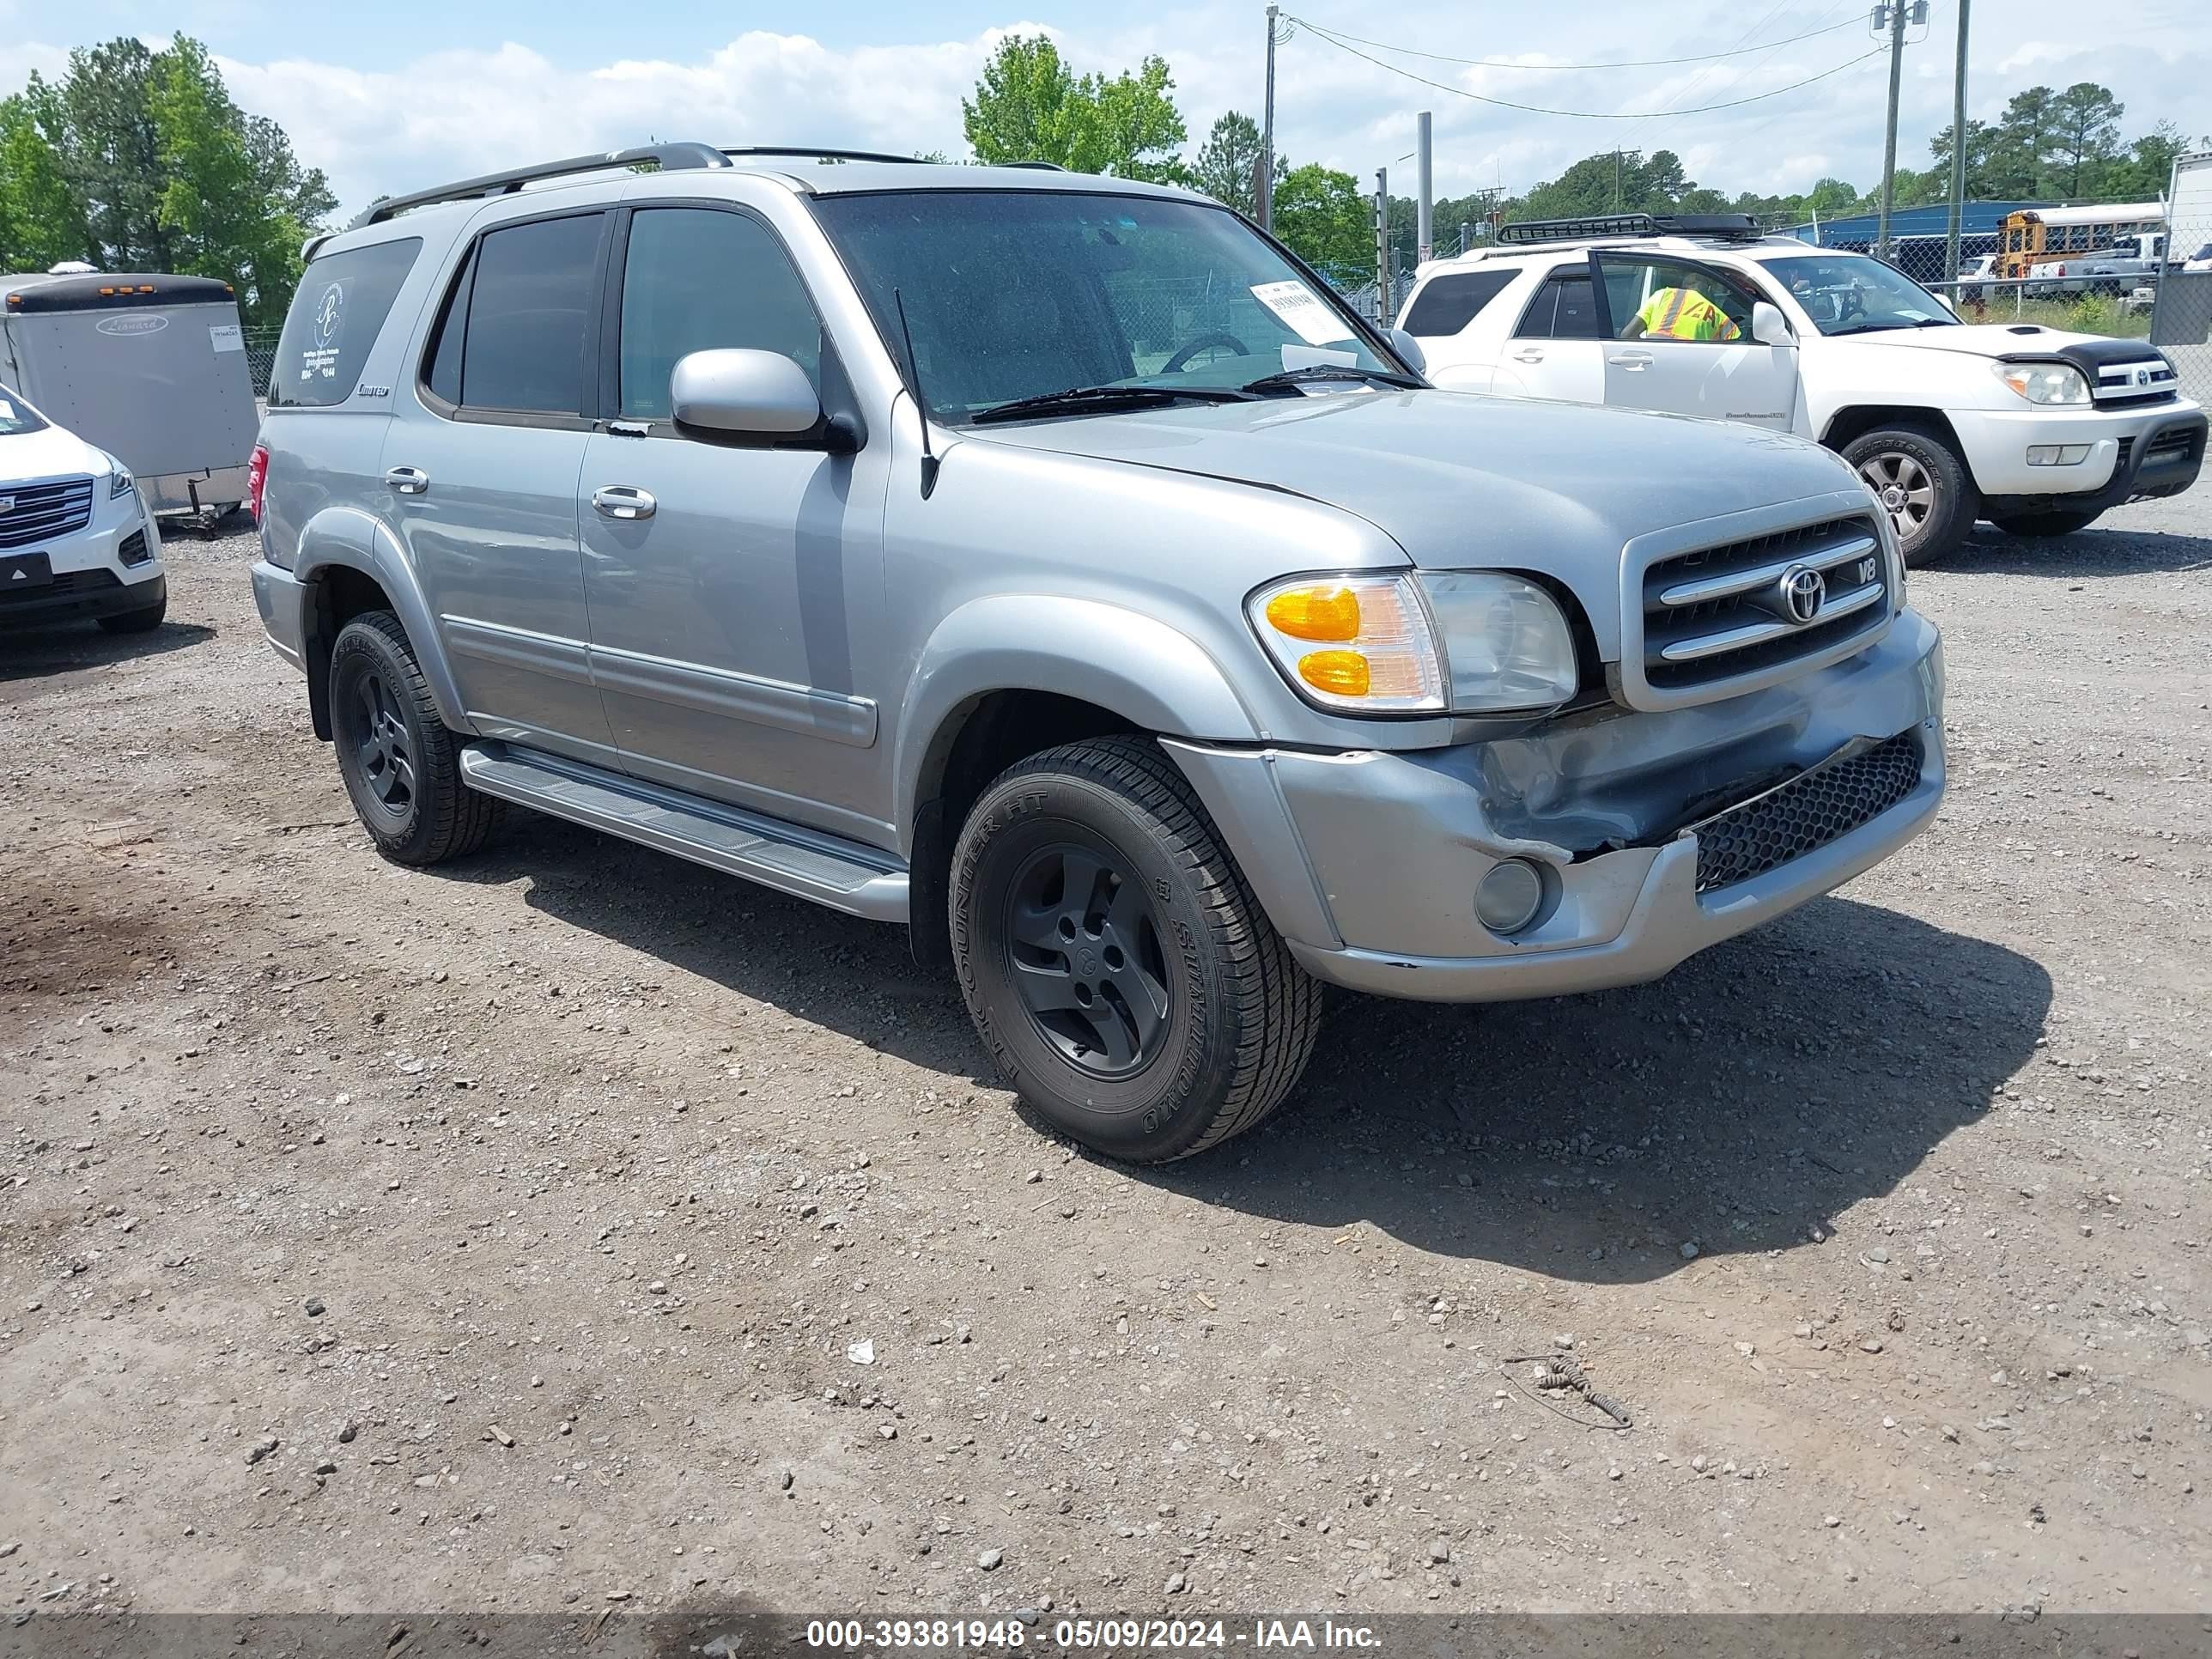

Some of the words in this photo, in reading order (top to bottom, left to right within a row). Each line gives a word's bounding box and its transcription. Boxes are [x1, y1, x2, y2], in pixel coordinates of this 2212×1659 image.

[1268, 294, 1315, 310] 39381948
[1858, 558, 1876, 585] V8
[1004, 790, 1049, 820] HT
[1142, 917, 1207, 1134] SUMITOMO
